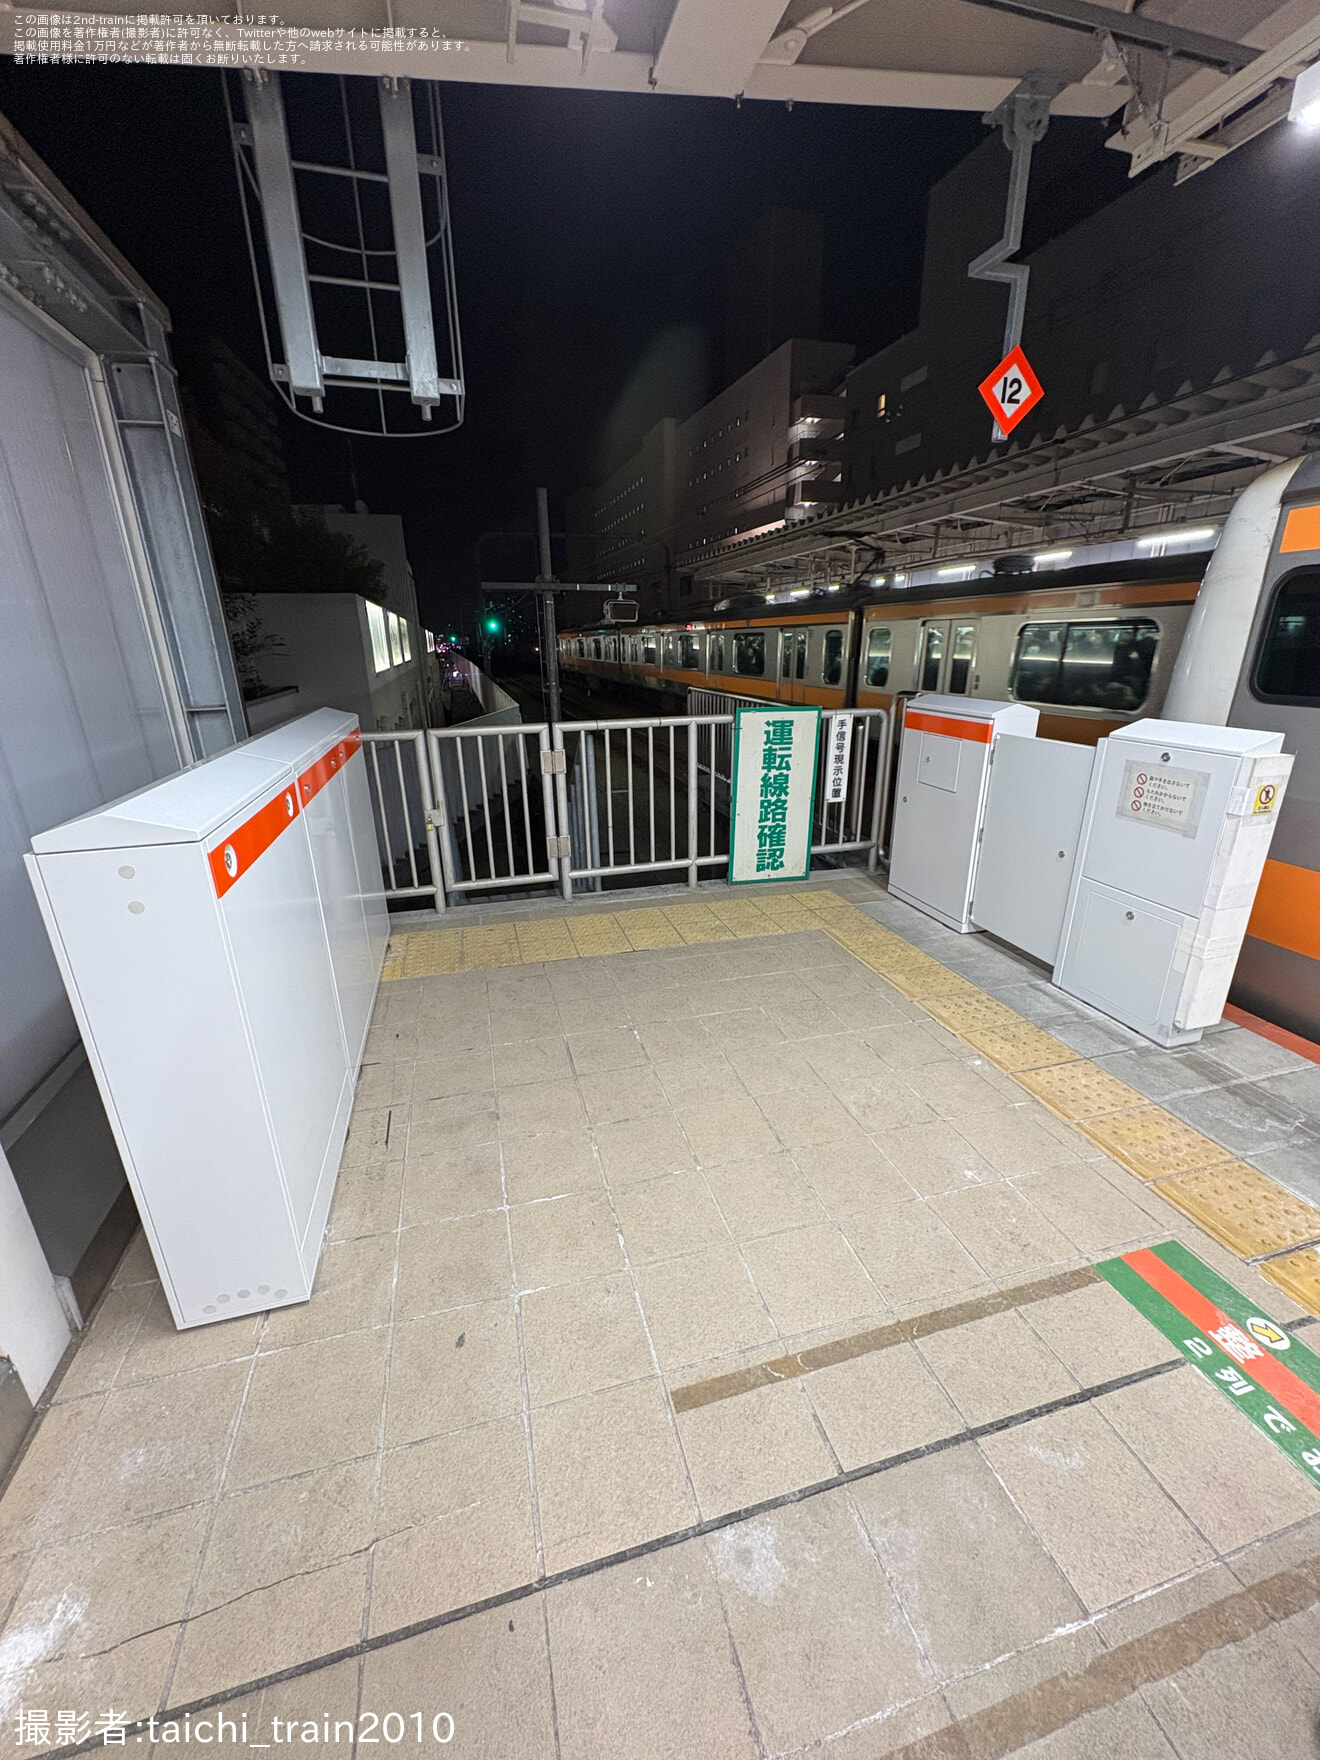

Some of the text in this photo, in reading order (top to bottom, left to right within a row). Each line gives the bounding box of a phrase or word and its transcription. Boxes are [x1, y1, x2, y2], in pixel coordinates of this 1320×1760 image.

[1001, 376, 1022, 404] 12
[831, 718, 847, 799] 手信号現示位置
[755, 719, 795, 873] 運転線路確認
[1207, 1323, 1265, 1364] 整
